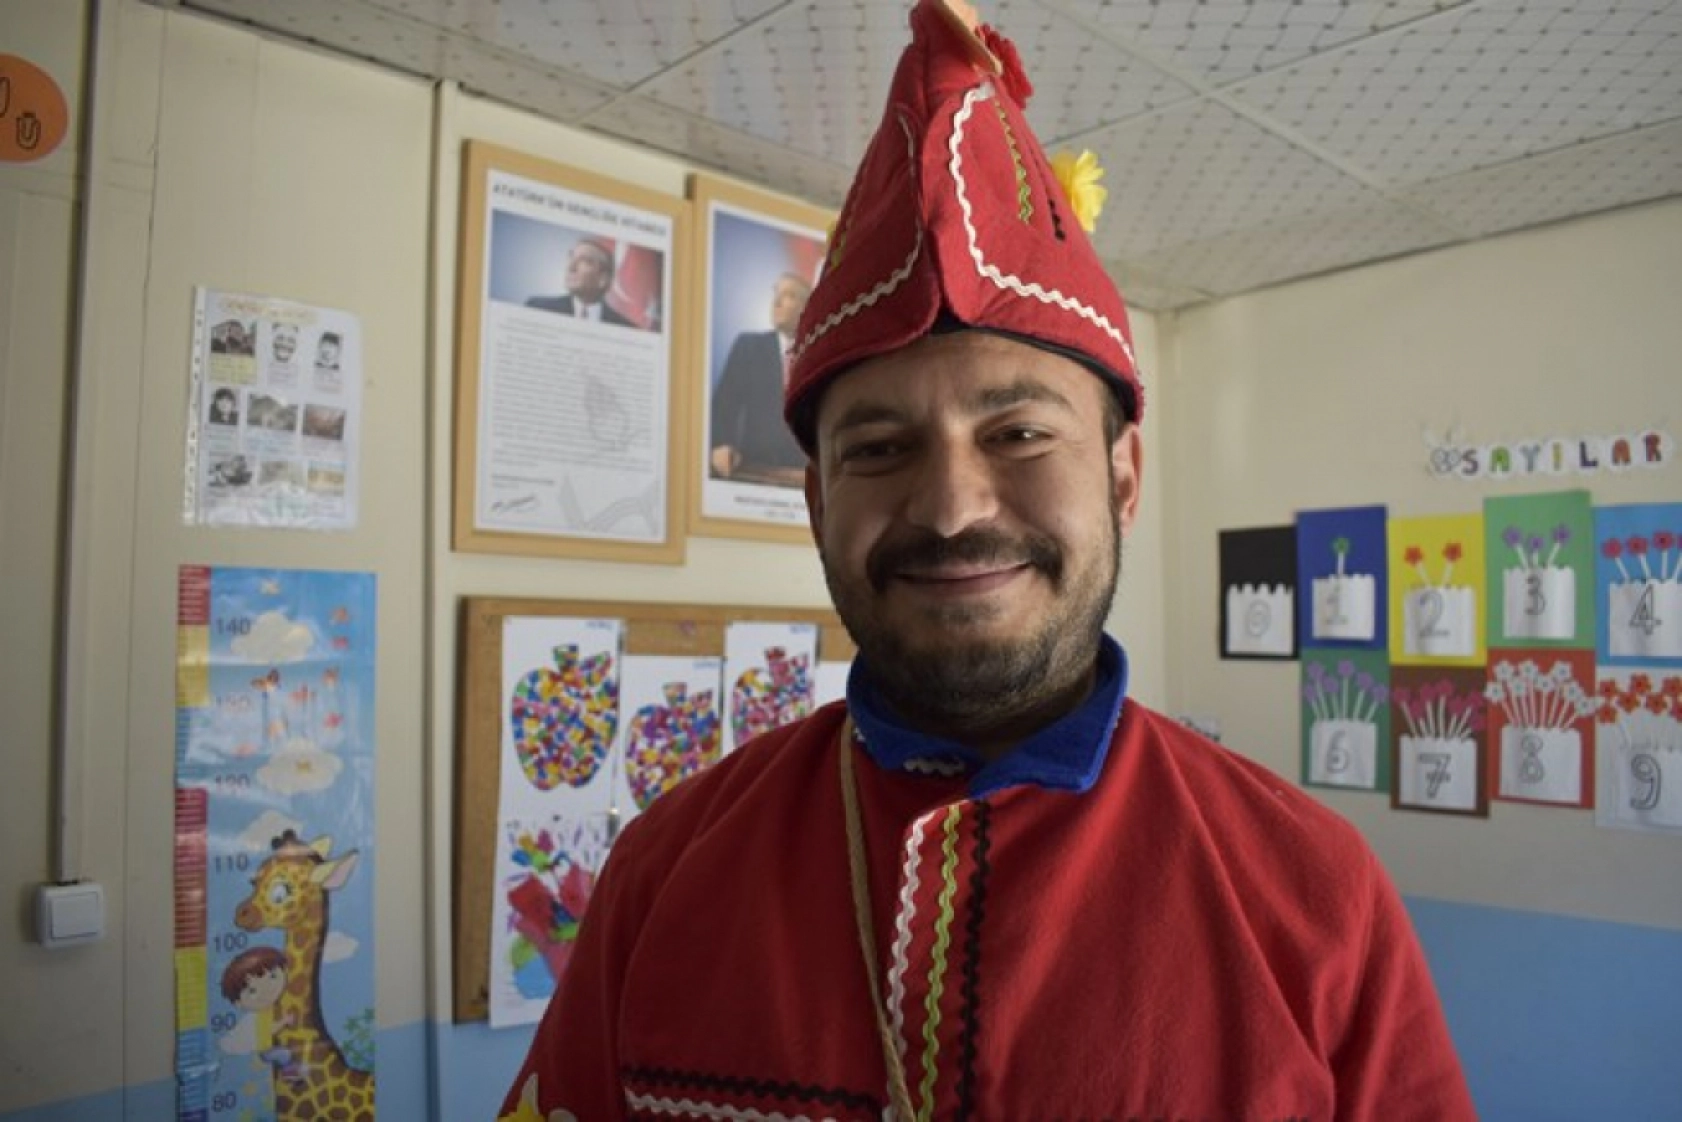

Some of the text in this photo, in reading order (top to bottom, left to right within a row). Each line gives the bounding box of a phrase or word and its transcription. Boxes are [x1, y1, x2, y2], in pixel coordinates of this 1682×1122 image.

[1461, 432, 1662, 474] SAYILAR
[1418, 589, 1451, 638] 2
[1524, 574, 1546, 616] 3
[1629, 584, 1663, 636] 4
[215, 616, 251, 635] 140
[1326, 730, 1350, 774] 6
[1518, 735, 1545, 784] 8
[1418, 752, 1452, 799] 7
[1630, 753, 1662, 810] 9
[215, 852, 249, 873] 110
[213, 932, 248, 953] 100
[210, 1011, 236, 1034] 90
[210, 1091, 237, 1113] 80
